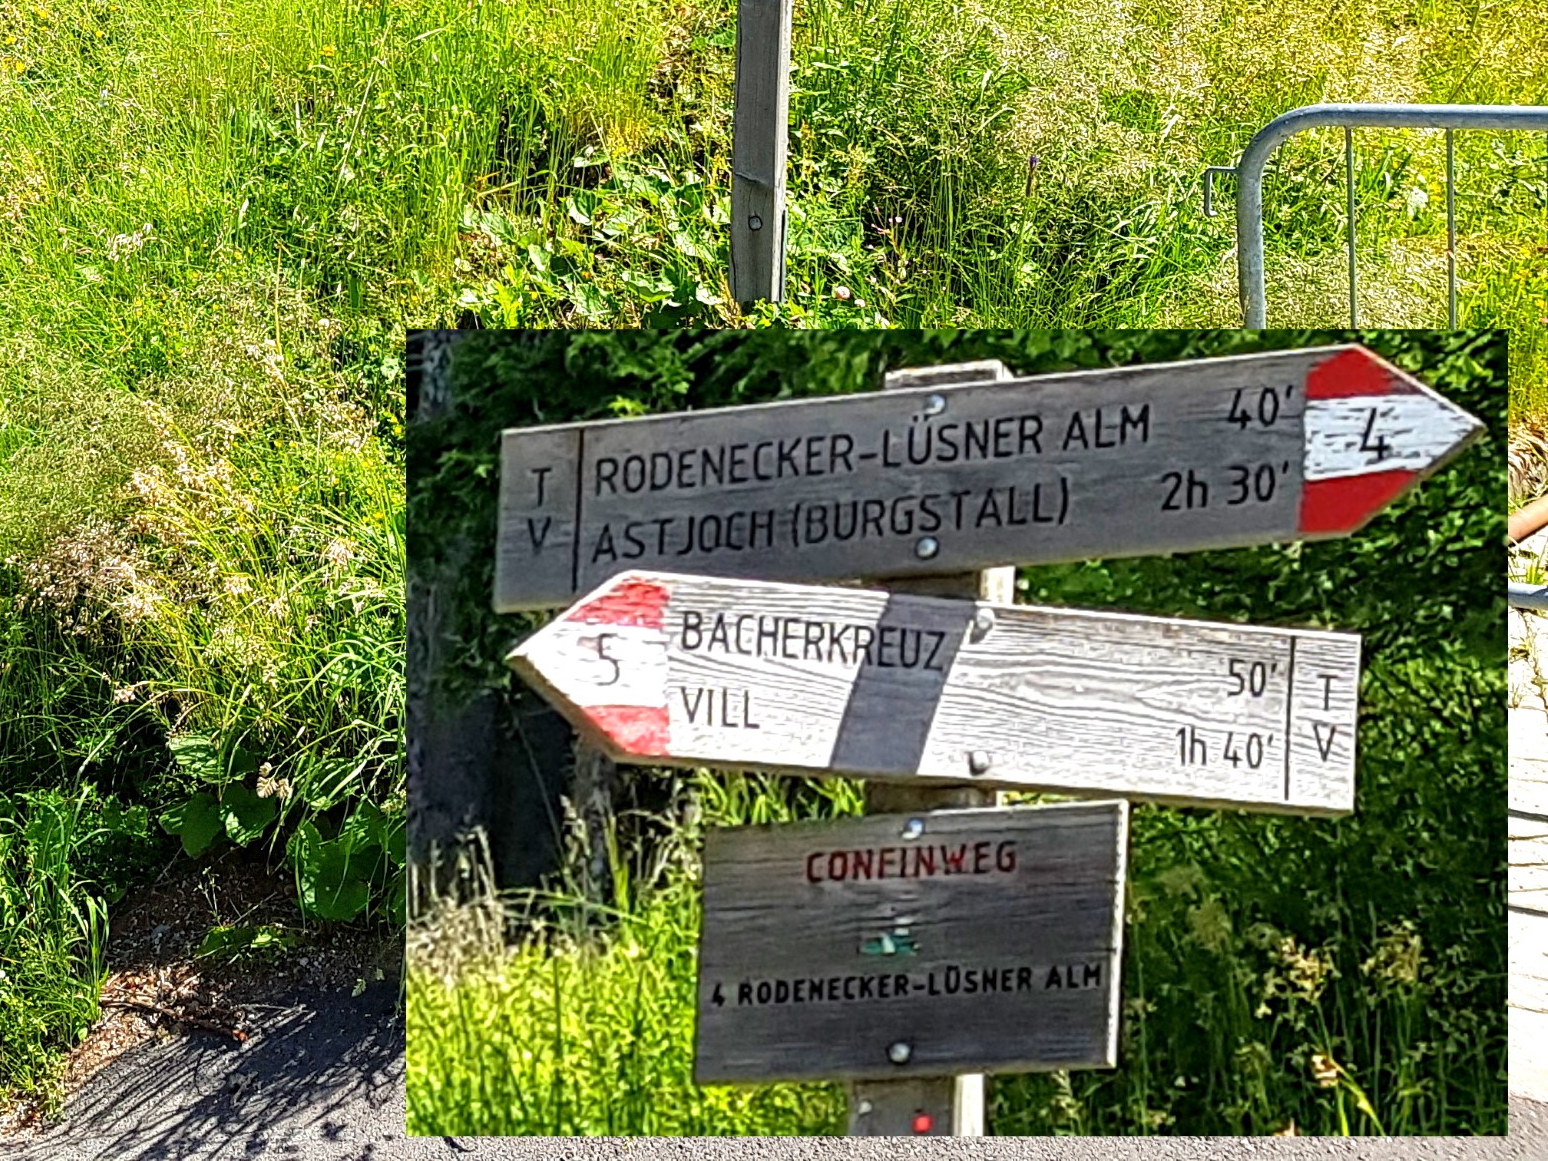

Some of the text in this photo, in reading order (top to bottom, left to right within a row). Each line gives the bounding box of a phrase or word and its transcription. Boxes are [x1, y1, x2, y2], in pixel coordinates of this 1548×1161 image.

[532, 385, 1293, 507] T RODENECKER-LÜSNER ALM 40'
[1359, 407, 1390, 461] 4
[527, 461, 1289, 563] V ASTJOCH (BURGSTALL) 2h 30'
[598, 633, 620, 685] 5
[681, 611, 1339, 711] BACHERKREUZ 50' T
[680, 688, 1337, 769] VILL 1h 40' V
[711, 964, 1102, 1007] 4 RODENECKER-LÜSNER ALM
